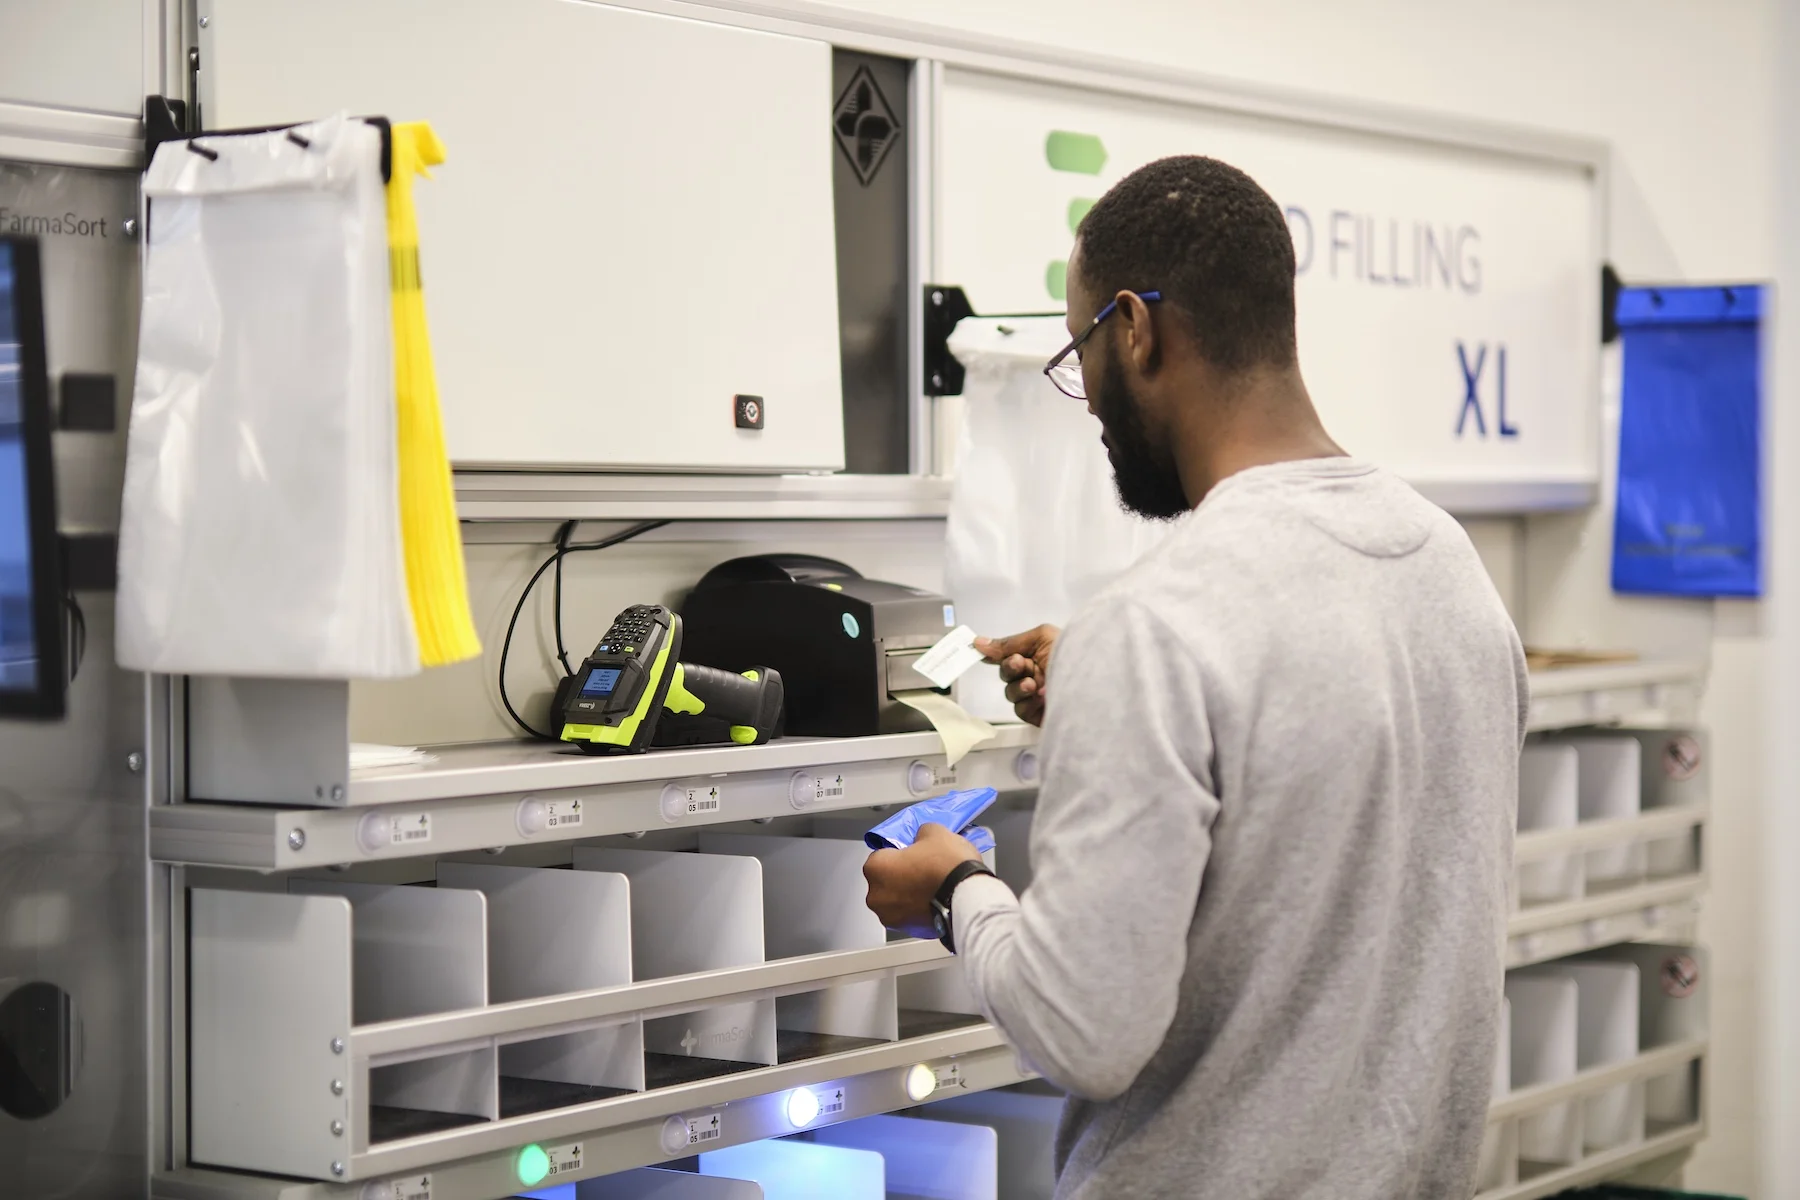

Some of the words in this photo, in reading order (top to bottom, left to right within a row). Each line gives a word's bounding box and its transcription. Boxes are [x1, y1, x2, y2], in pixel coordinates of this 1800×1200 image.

[0, 206, 107, 238] FarmaSort
[1329, 209, 1482, 295] FILLING
[1455, 341, 1519, 439] XL
[816, 790, 824, 798] 07
[688, 804, 697, 812] 05
[690, 1134, 698, 1143] 05
[549, 1166, 558, 1175] 03
